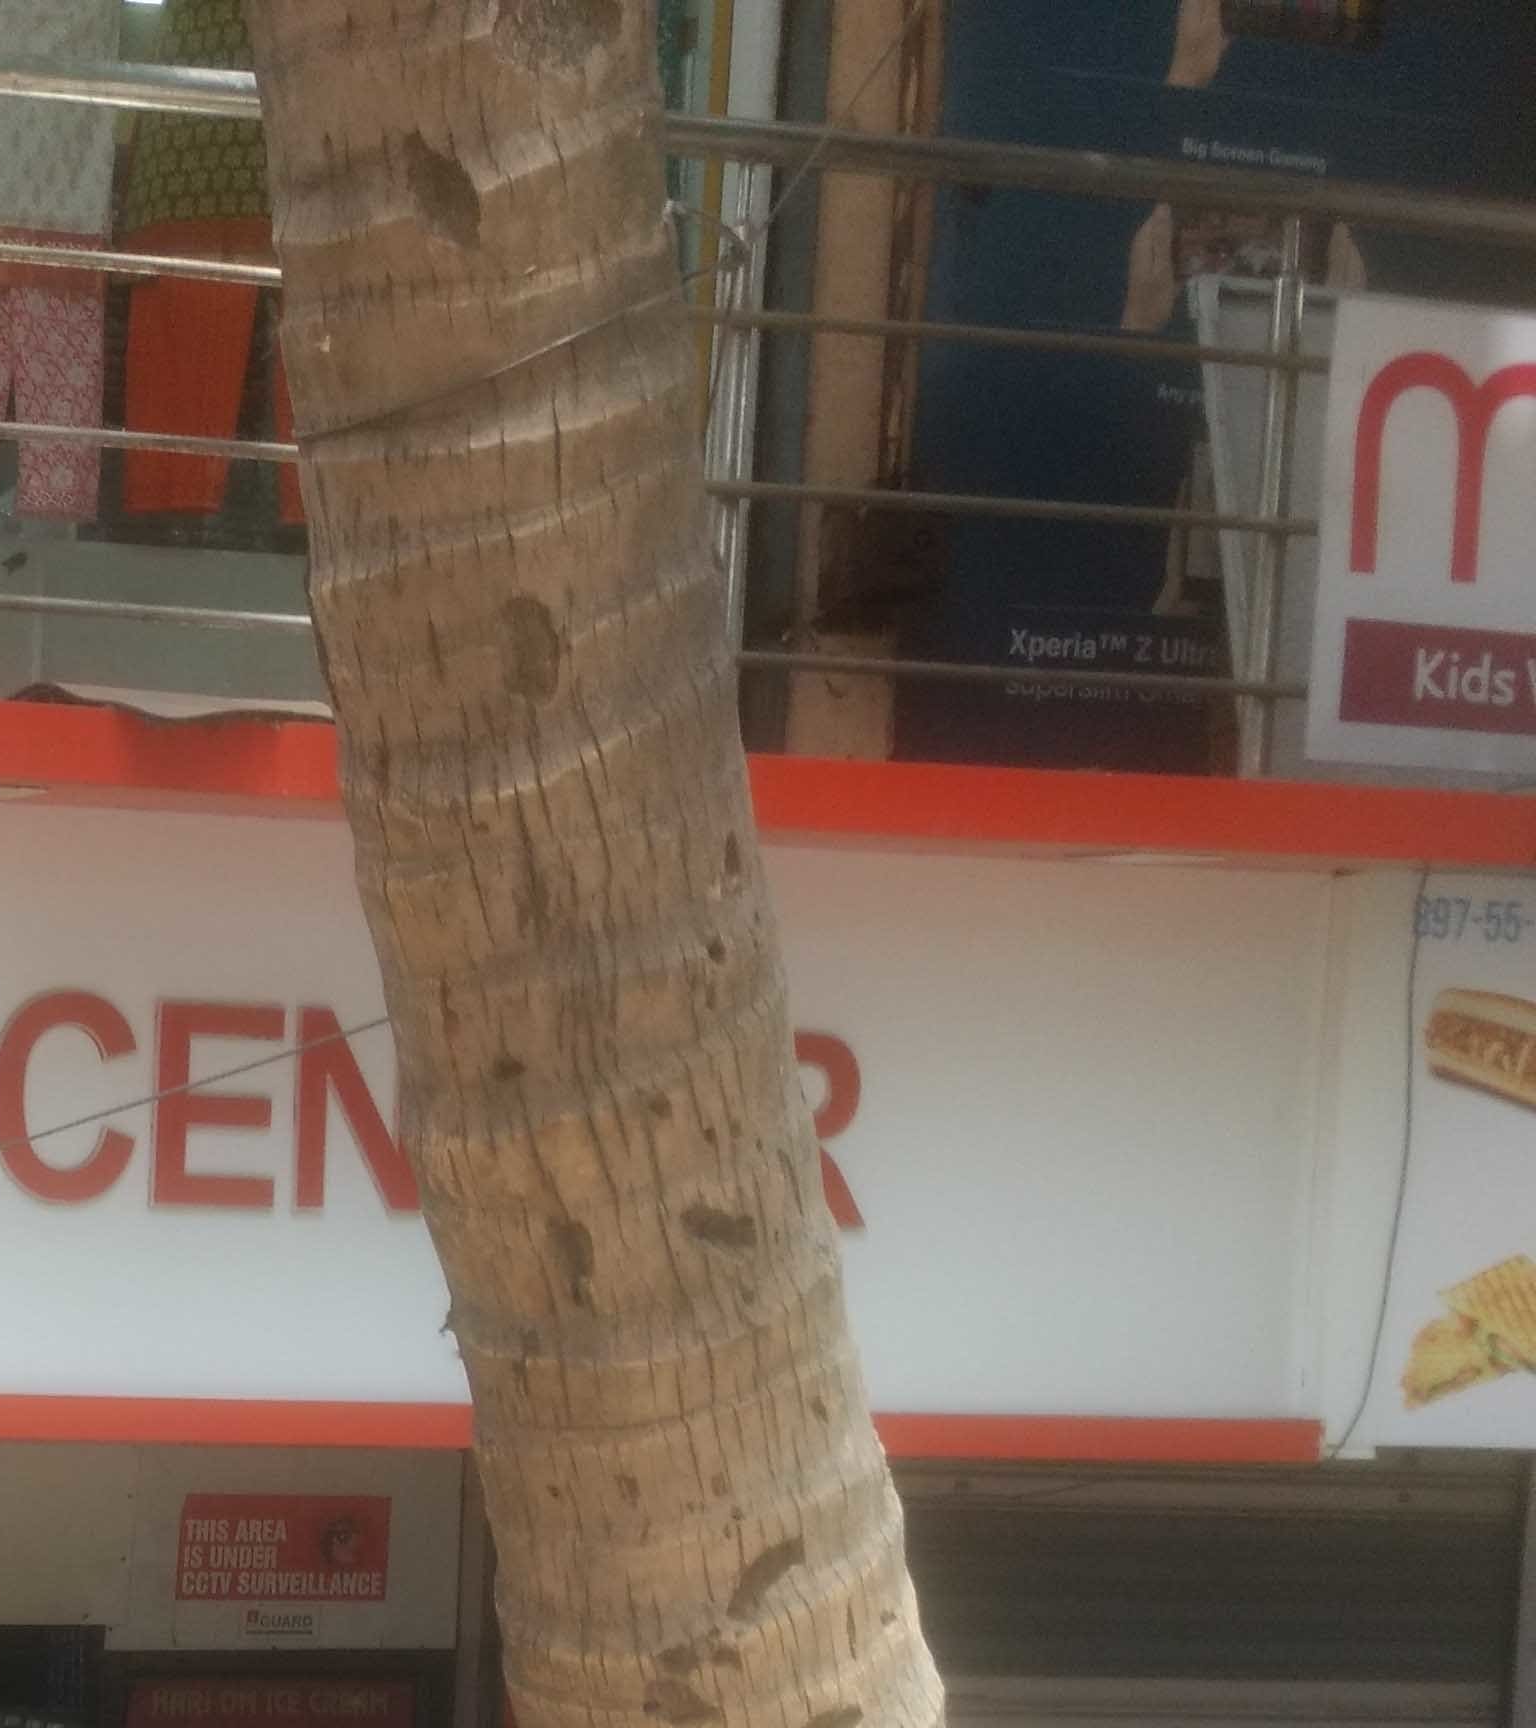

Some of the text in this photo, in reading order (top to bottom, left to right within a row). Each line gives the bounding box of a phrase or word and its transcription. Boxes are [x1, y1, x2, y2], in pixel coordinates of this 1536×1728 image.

[1134, 635, 1152, 661] Z
[1413, 647, 1515, 706] Kids
[185, 1519, 287, 1543] THIS AREA
[183, 1545, 277, 1570] IS UNDER
[182, 1570, 382, 1597] CCTV SURVEILLANCE
